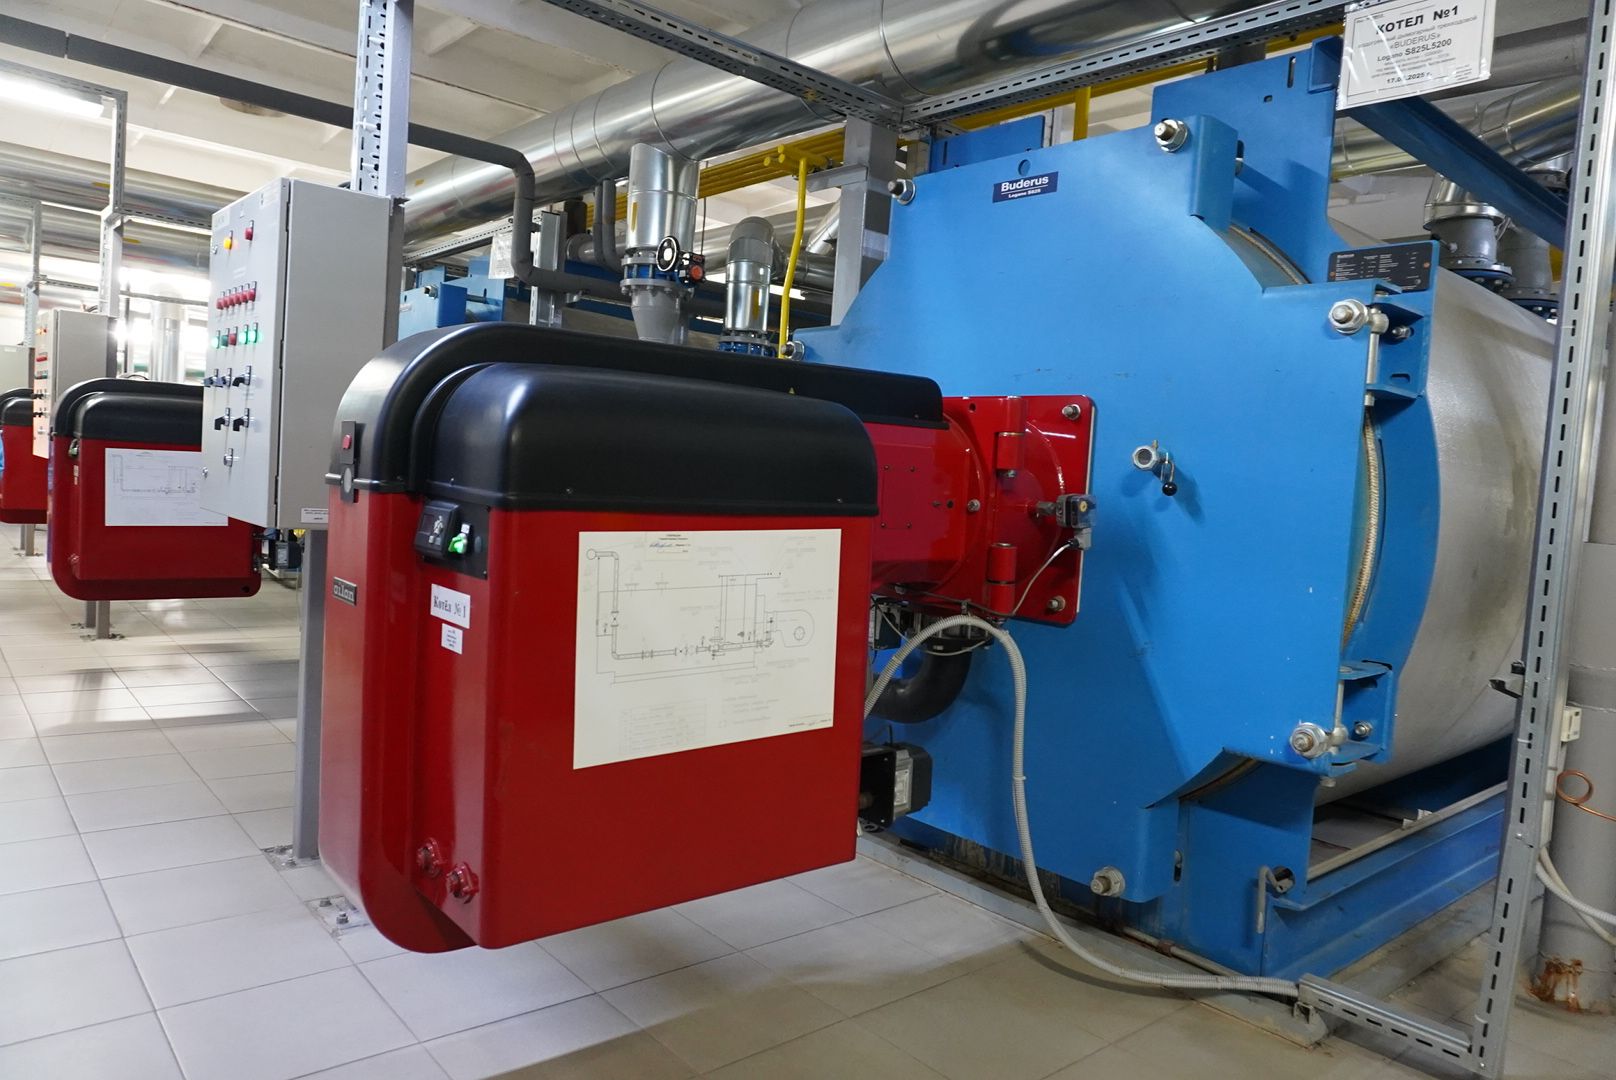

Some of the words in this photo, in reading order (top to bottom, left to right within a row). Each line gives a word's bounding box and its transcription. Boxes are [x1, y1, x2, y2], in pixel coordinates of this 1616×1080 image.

[1376, 14, 1424, 35] КОТЕЛ
[1433, 5, 1458, 21] №1
[1405, 38, 1452, 56] S825L5200
[1387, 71, 1425, 84] 17.0.2025
[1001, 176, 1049, 192] Buderus
